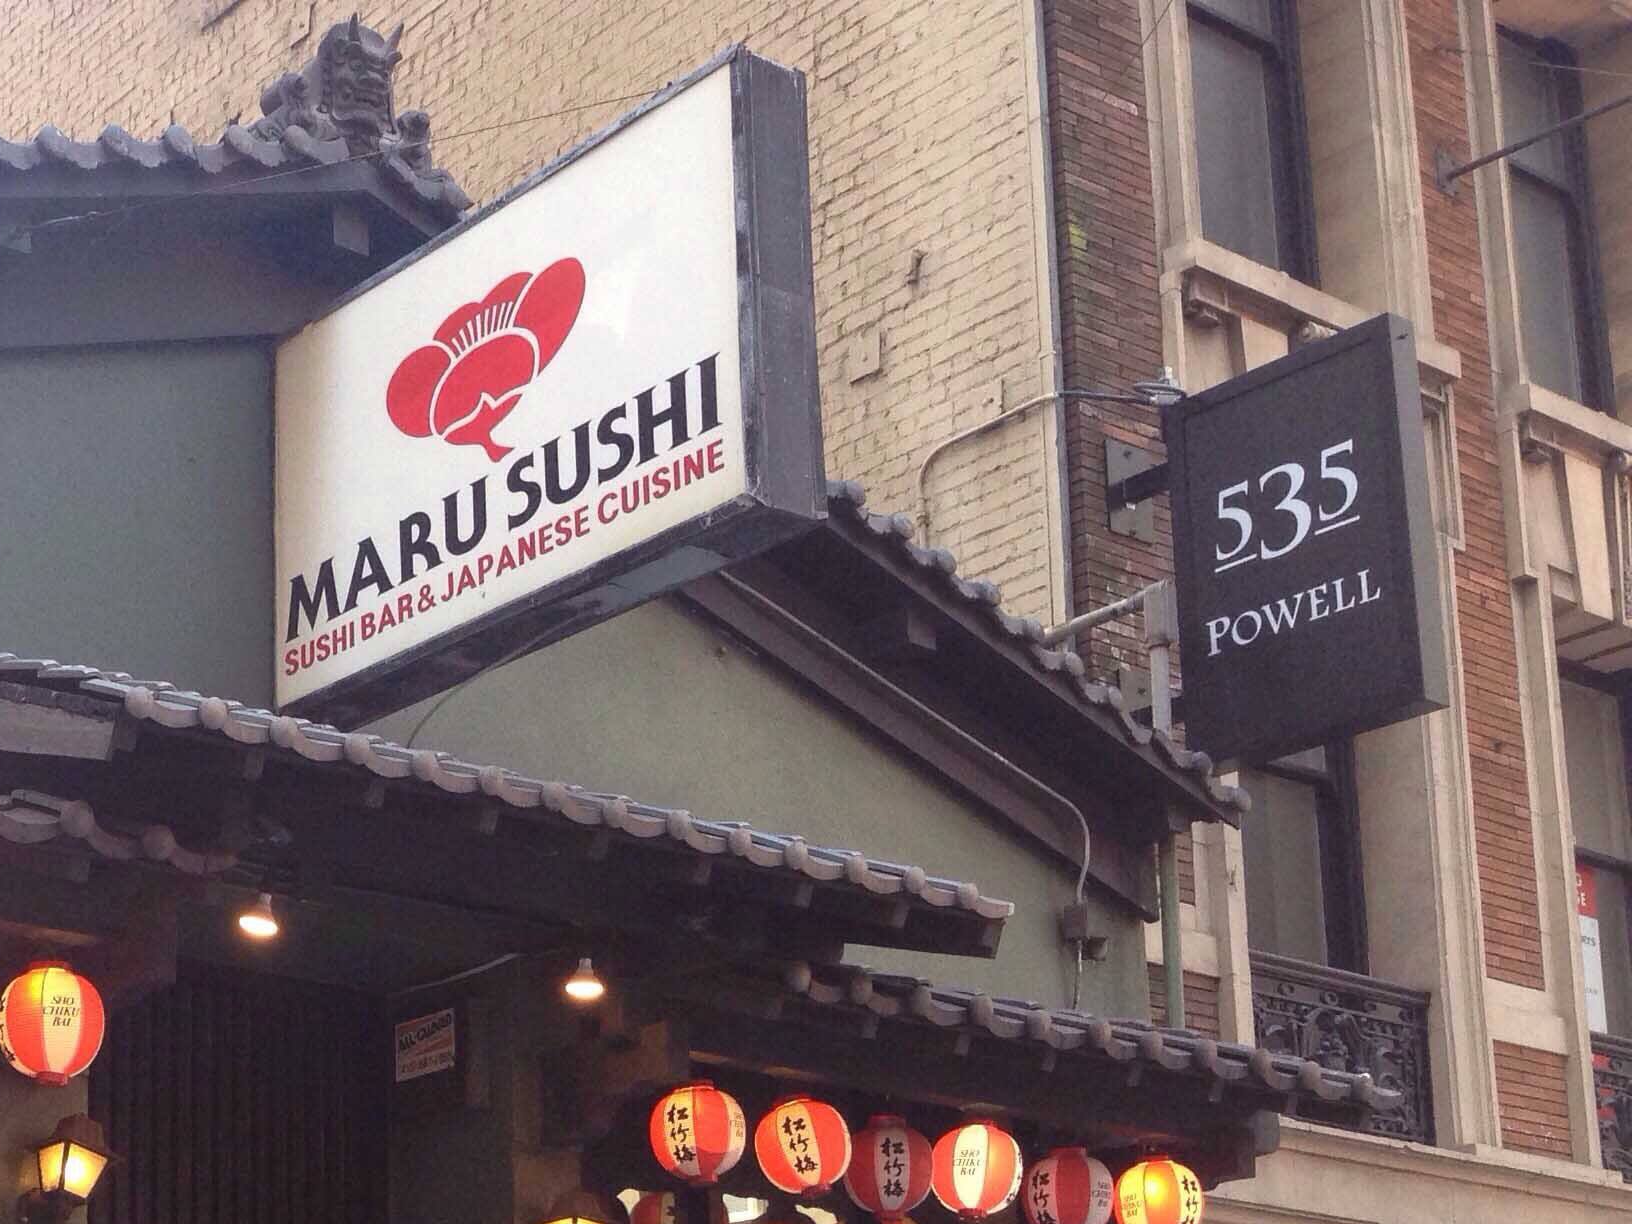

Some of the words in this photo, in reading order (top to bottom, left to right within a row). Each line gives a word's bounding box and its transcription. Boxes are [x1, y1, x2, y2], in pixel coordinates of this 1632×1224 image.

[284, 621, 356, 676] SUSHI
[441, 506, 591, 602] JAPANESE
[597, 438, 726, 524] CUISINE
[286, 475, 489, 643] MARU
[506, 352, 723, 530] SUSHI
[1215, 438, 1358, 561] 535
[1205, 568, 1381, 657] POWELL
